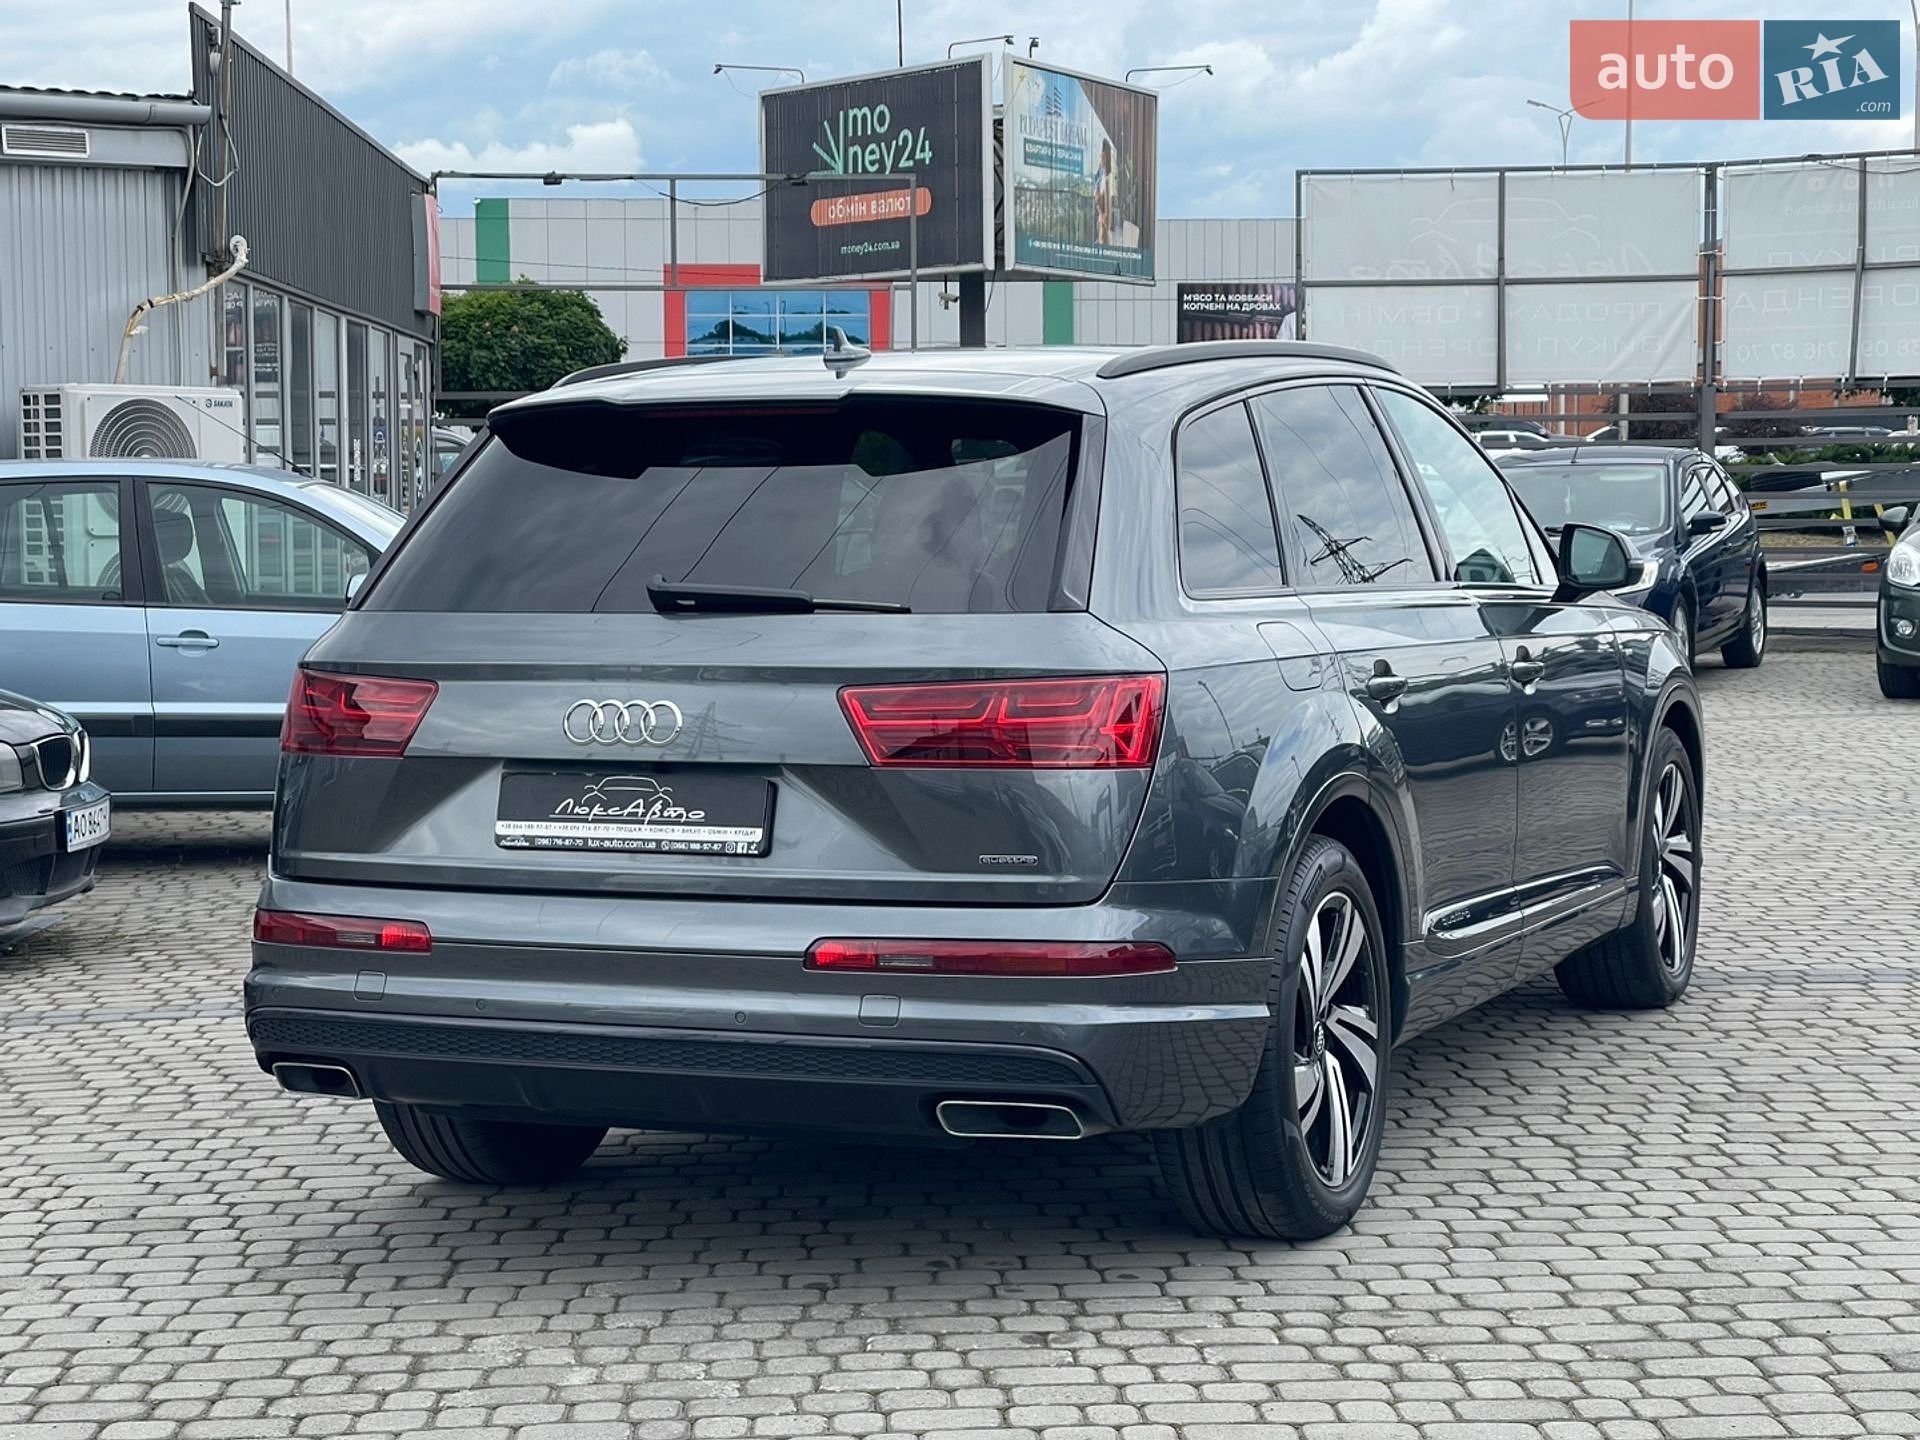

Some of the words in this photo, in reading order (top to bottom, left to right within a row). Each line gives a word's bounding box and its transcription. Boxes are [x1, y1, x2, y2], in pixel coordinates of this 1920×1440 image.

[828, 196, 867, 219] обмін
[871, 196, 912, 215] валют
[841, 240, 900, 256] money24.com.ua
[1214, 293, 1227, 302] ТА
[1228, 293, 1274, 302] КОВБАСИ
[1183, 302, 1225, 311] КОПЧЕНІ
[1226, 302, 1241, 311] НА
[1241, 302, 1281, 312] ДРОВАХ
[588, 838, 656, 849] lux-auto.com.ua
